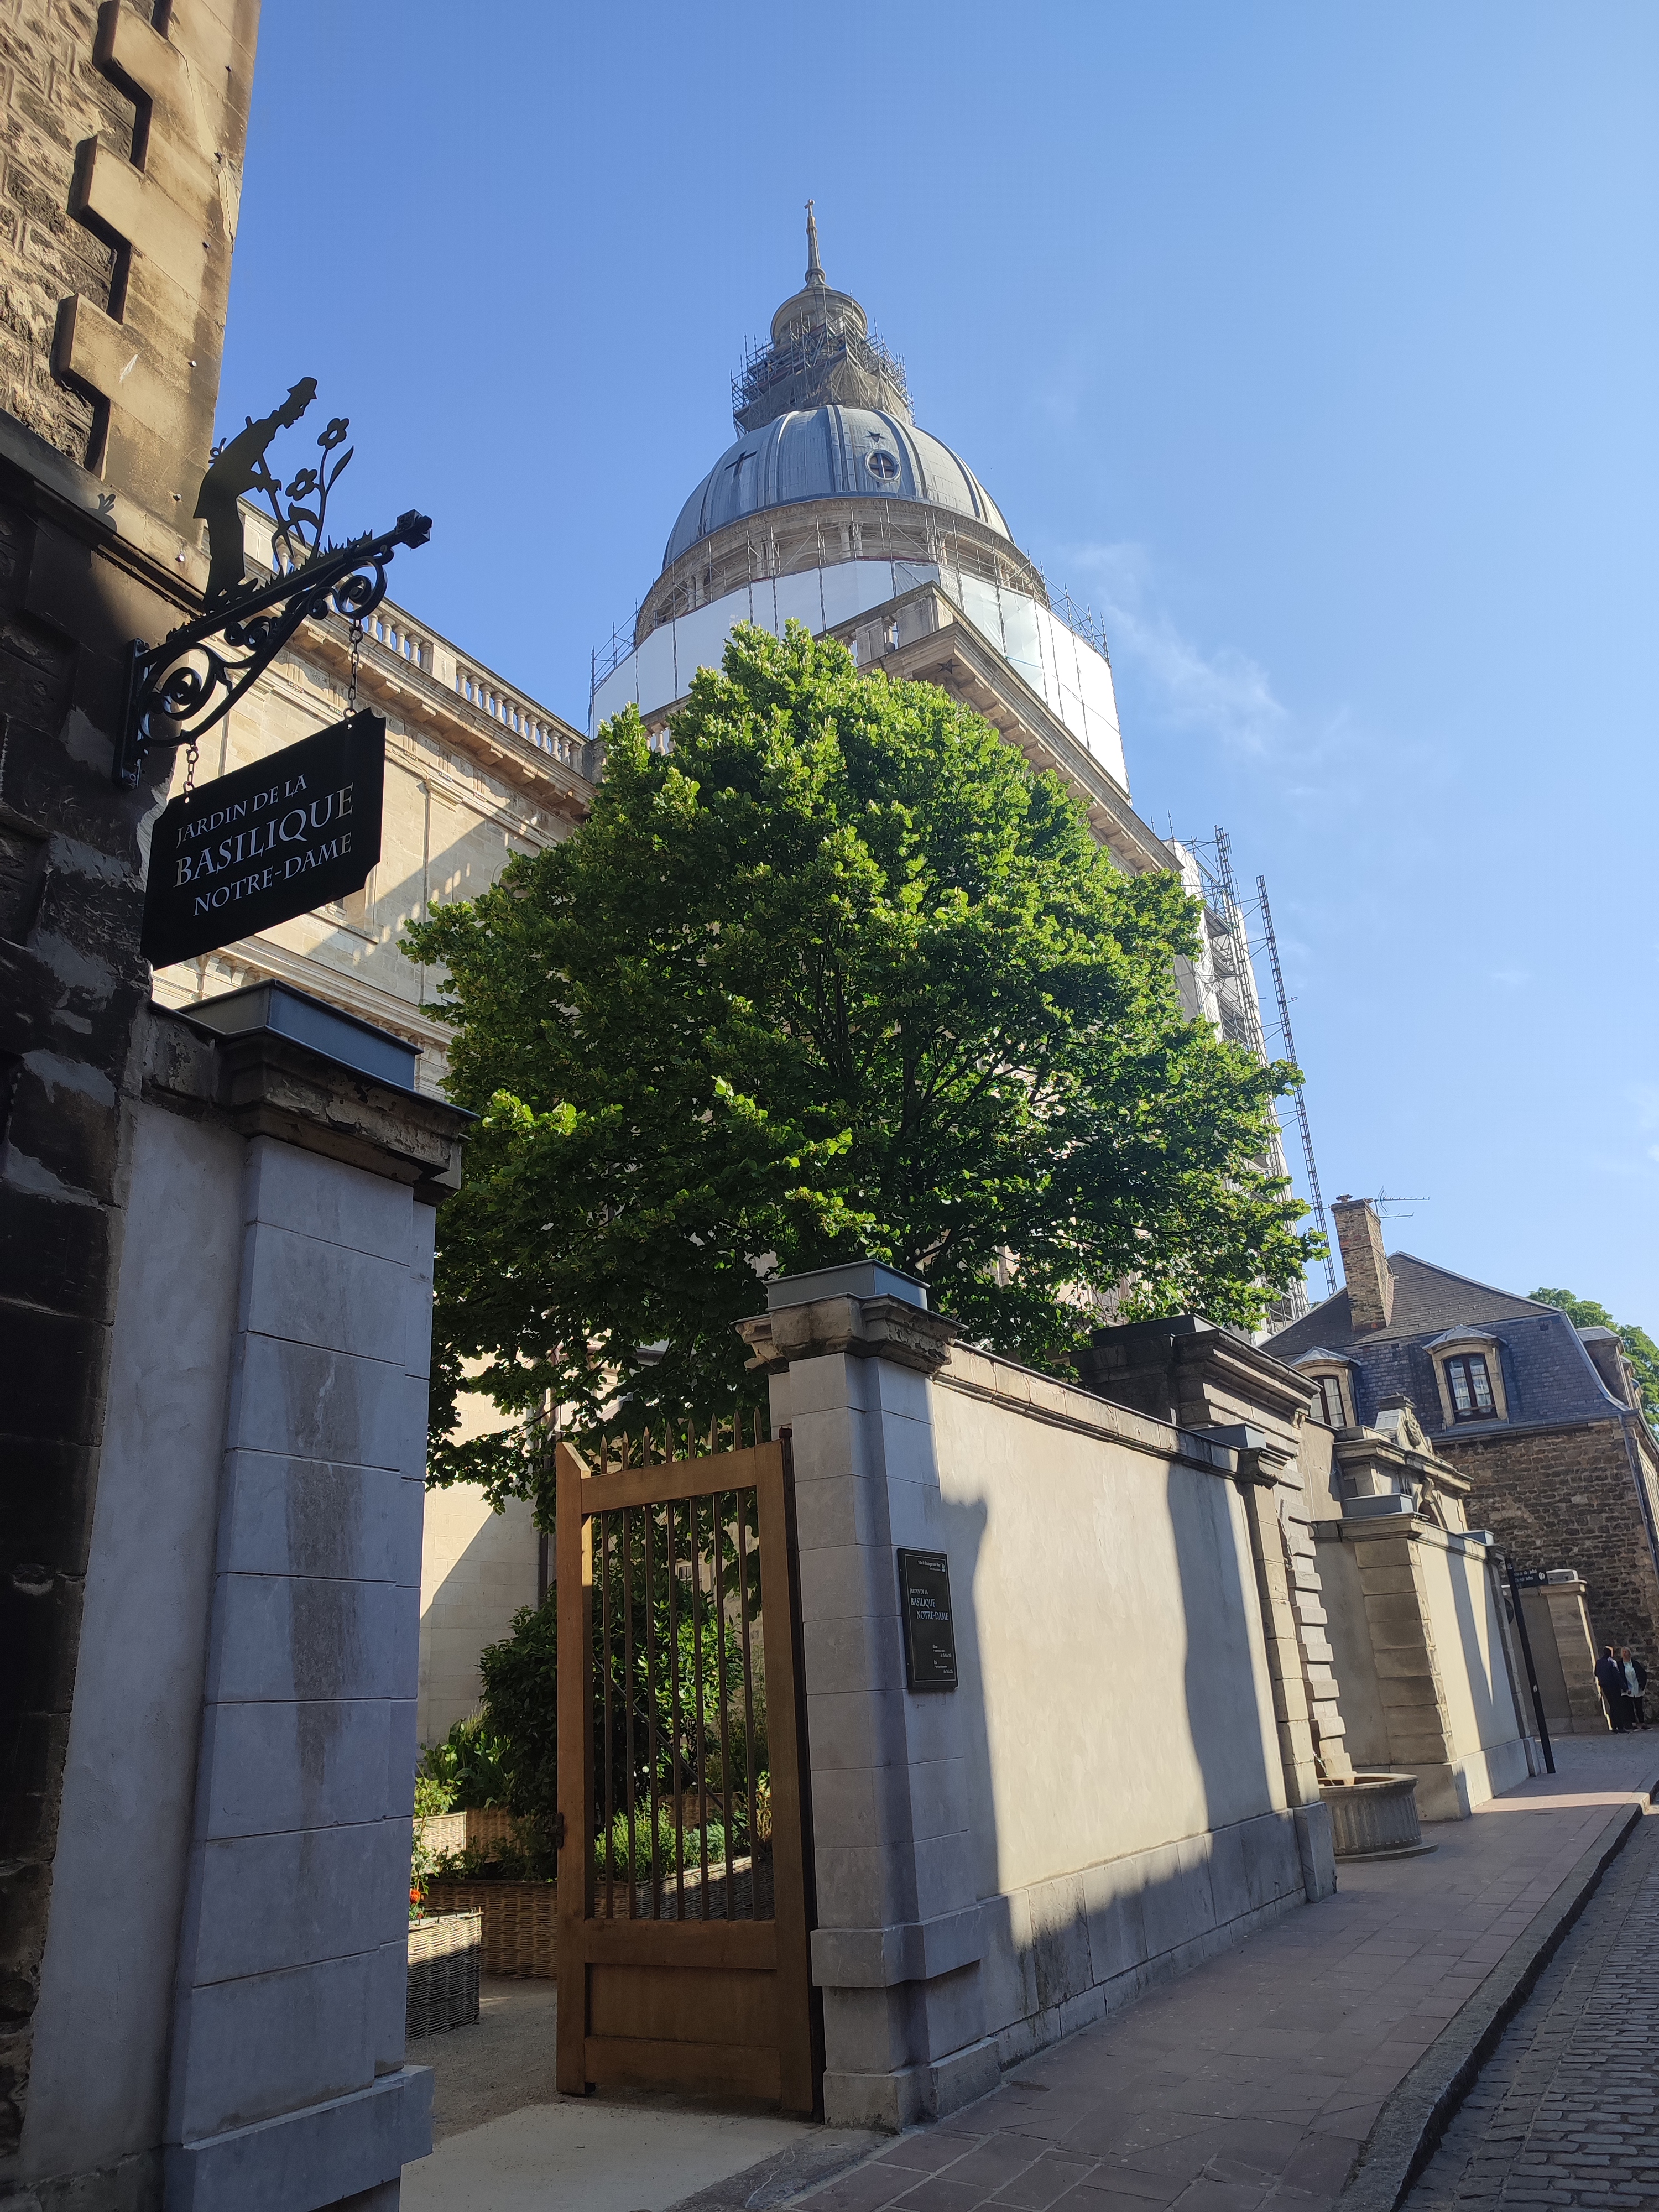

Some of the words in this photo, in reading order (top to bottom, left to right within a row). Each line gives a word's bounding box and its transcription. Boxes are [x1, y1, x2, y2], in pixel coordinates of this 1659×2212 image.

[173, 782, 354, 888] BASILIQUE
[176, 799, 248, 849] JARDIN
[252, 785, 279, 813] DE
[283, 774, 308, 799] LA
[192, 831, 352, 917] NOTRE-DAME
[910, 1597, 936, 1609] BASILIQUE
[916, 1610, 949, 1621] NOTRE-DAME
